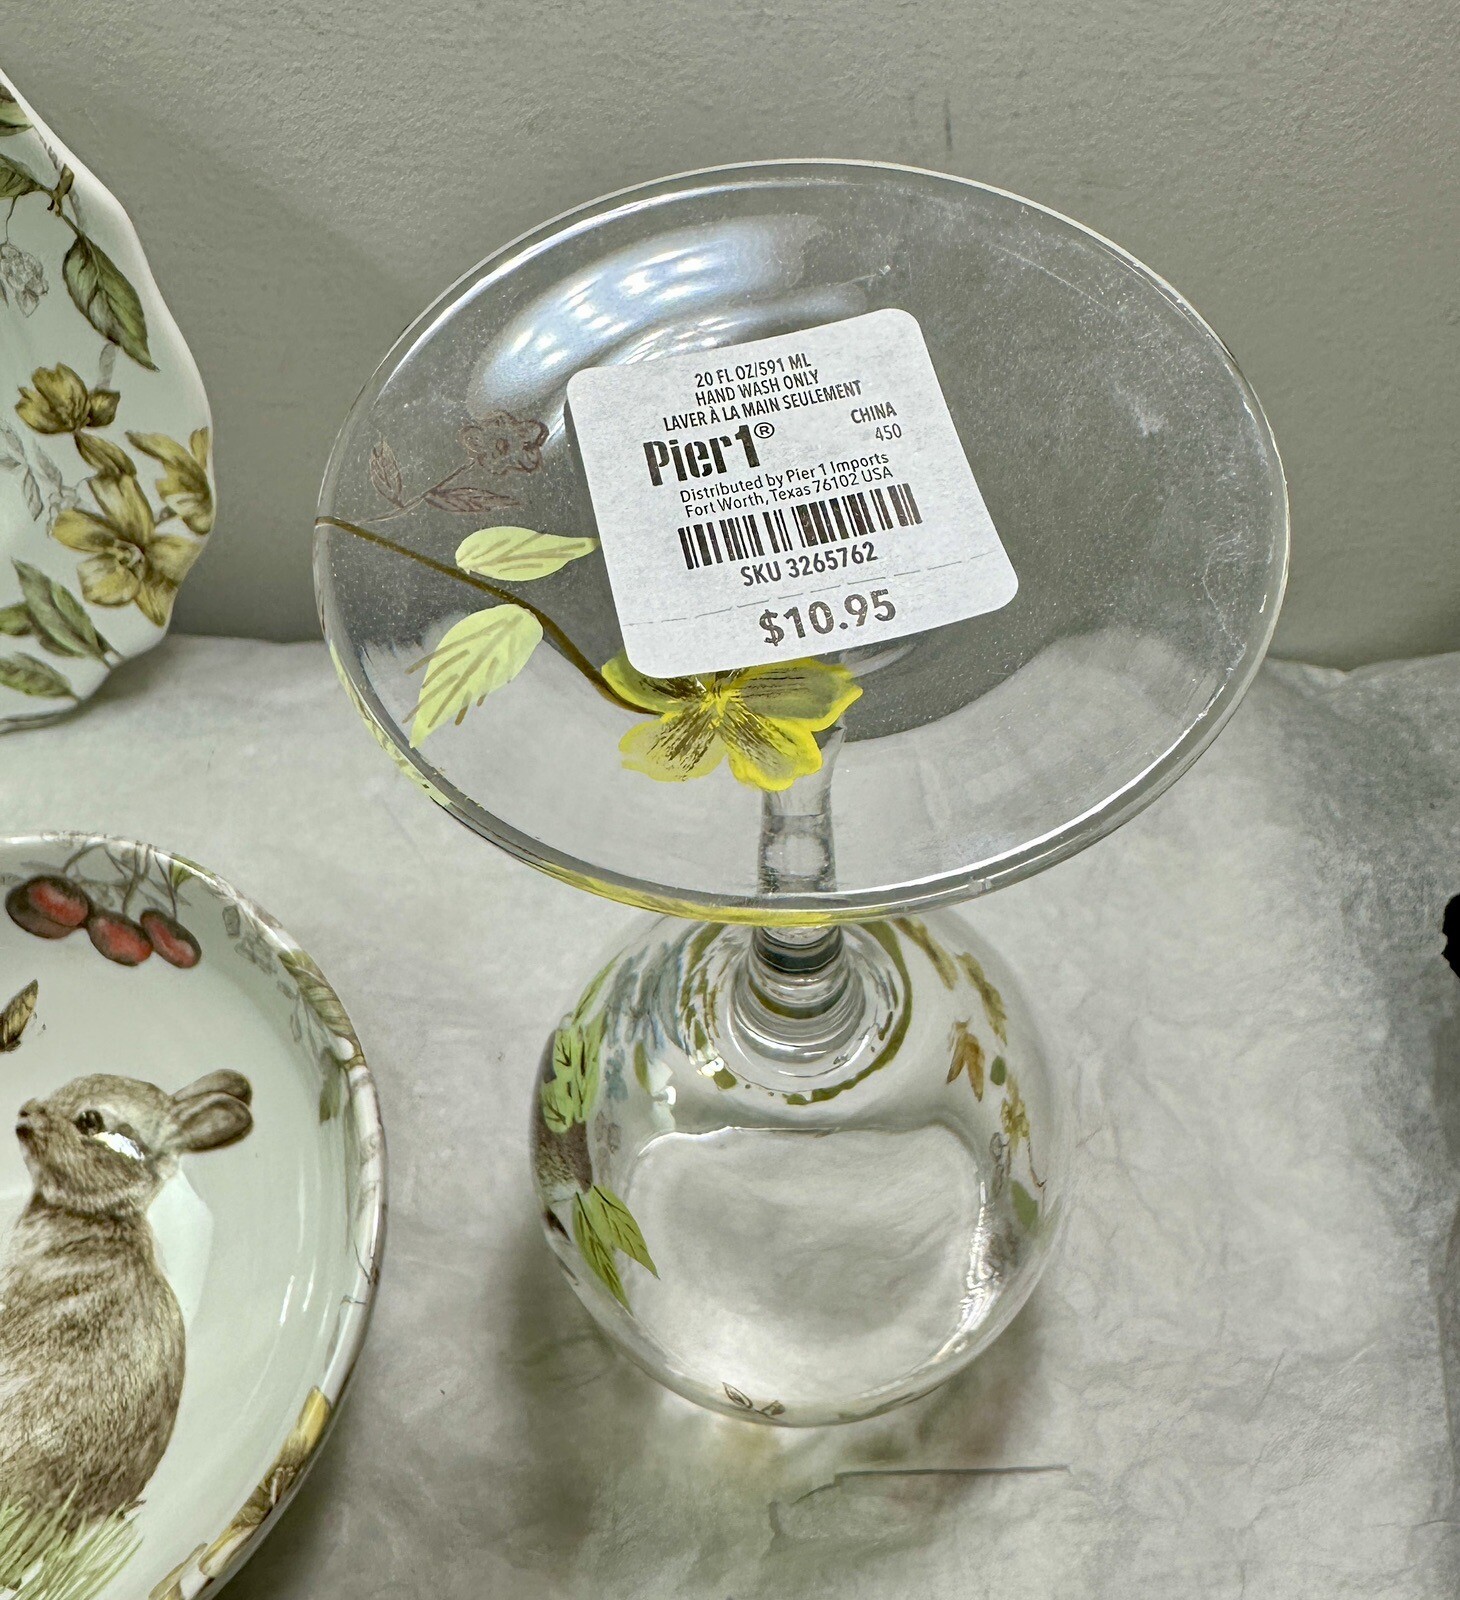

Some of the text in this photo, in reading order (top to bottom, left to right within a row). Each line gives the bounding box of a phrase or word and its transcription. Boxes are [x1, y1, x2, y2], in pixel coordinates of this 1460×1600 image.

[694, 353, 811, 388] 20 FL OZ/591 ML
[695, 369, 819, 406] HAND WASH ONLY
[663, 380, 861, 431] LAVER À LA MAIN SEULEMENT
[850, 401, 898, 424] CHINA
[875, 423, 902, 441] 450
[680, 453, 889, 503] Distributed by Pier 1 Imports
[685, 466, 893, 518] Fort Worth, Texas 76102 USA
[740, 541, 878, 587] SKU 3265762
[759, 588, 896, 647] $10.95
